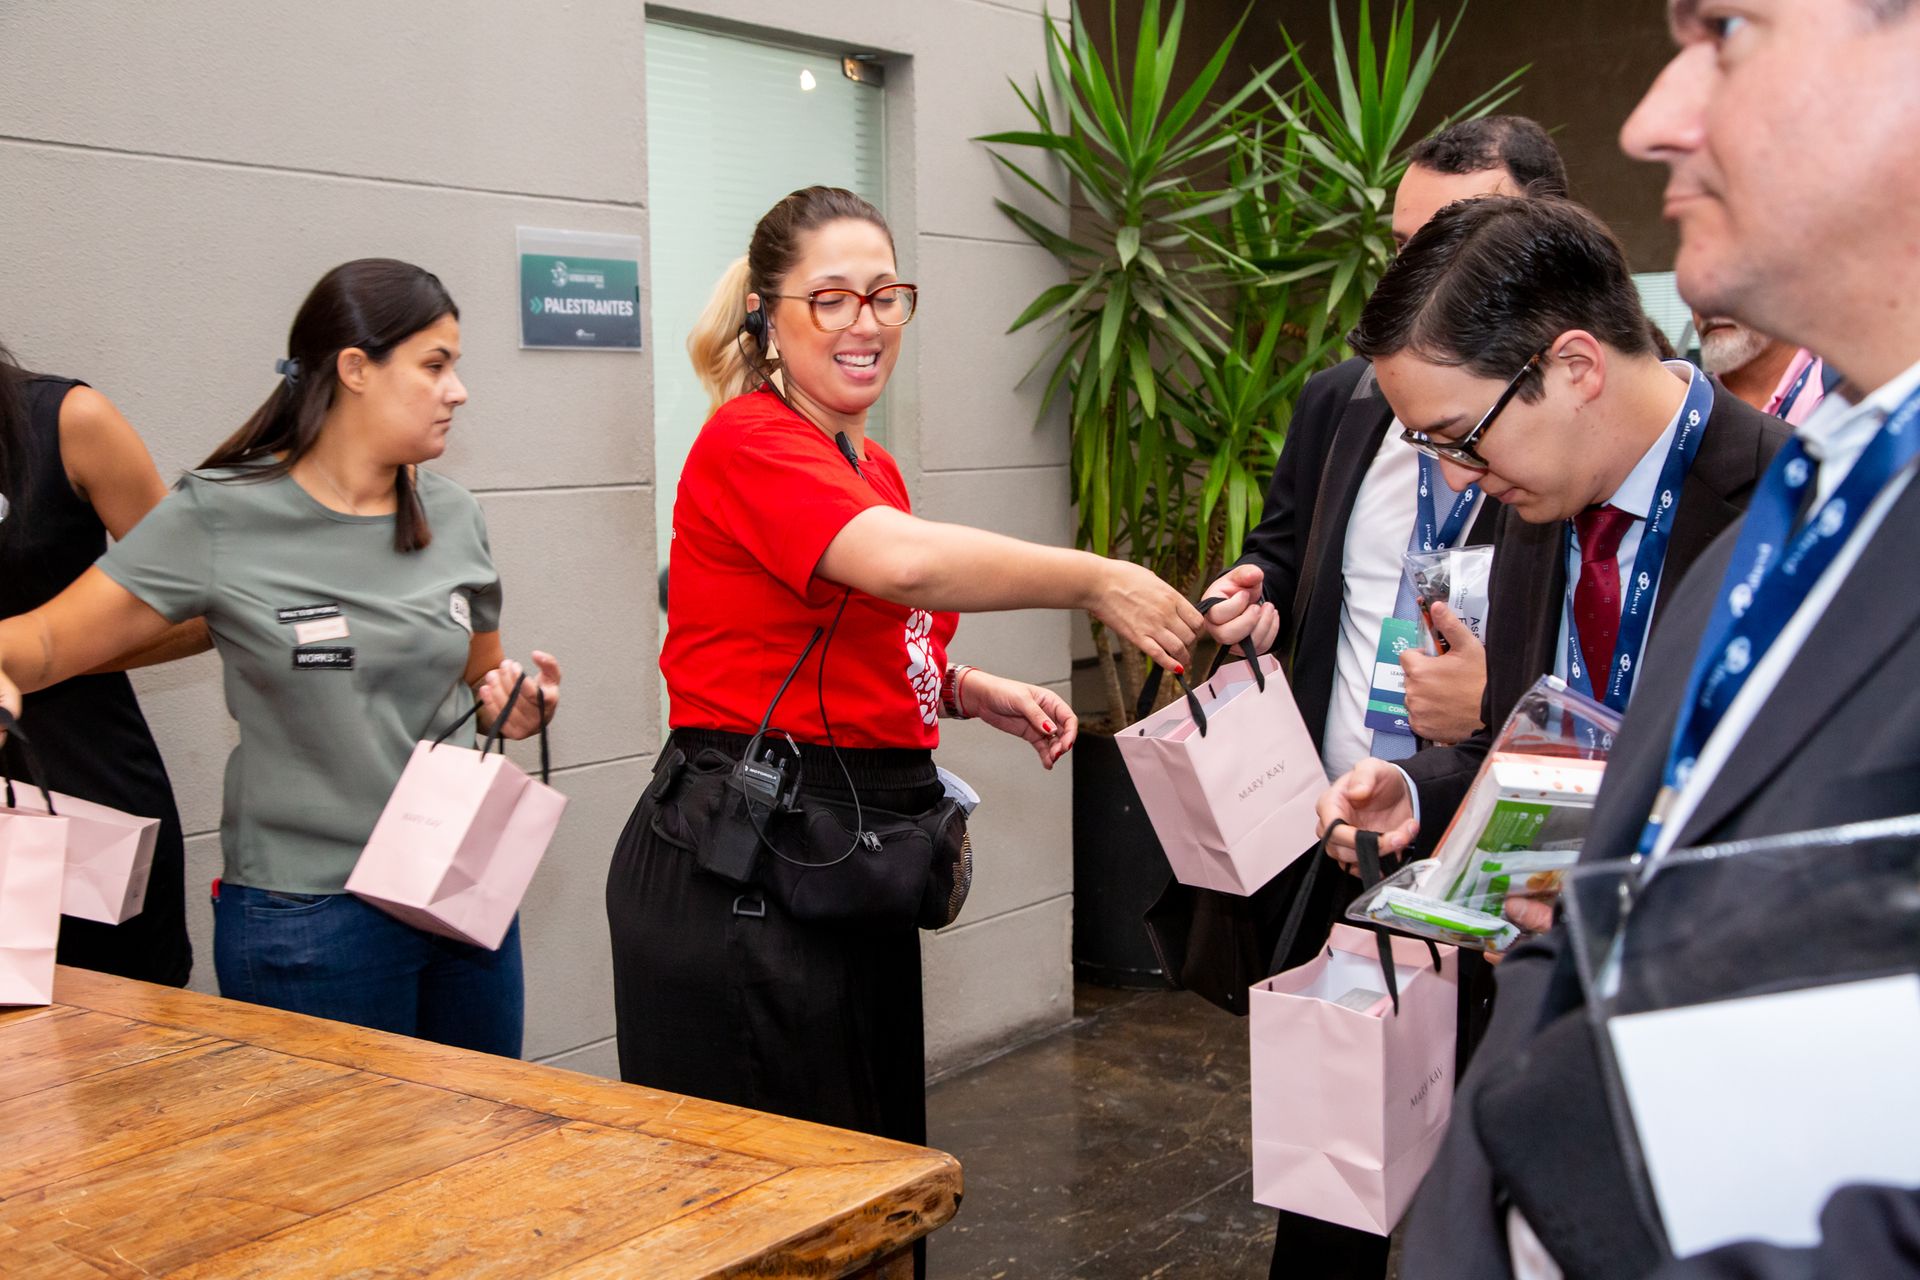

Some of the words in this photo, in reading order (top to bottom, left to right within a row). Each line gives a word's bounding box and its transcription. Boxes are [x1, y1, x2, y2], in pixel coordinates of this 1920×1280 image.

[544, 297, 633, 316] PALESTRANTES
[1470, 616, 1481, 640] Ass
[749, 767, 777, 780] MOTOROLA
[1238, 775, 1265, 802] MARY
[1265, 760, 1285, 780] KAY
[1409, 1077, 1429, 1110] MARY
[1429, 1063, 1443, 1086] KAY
